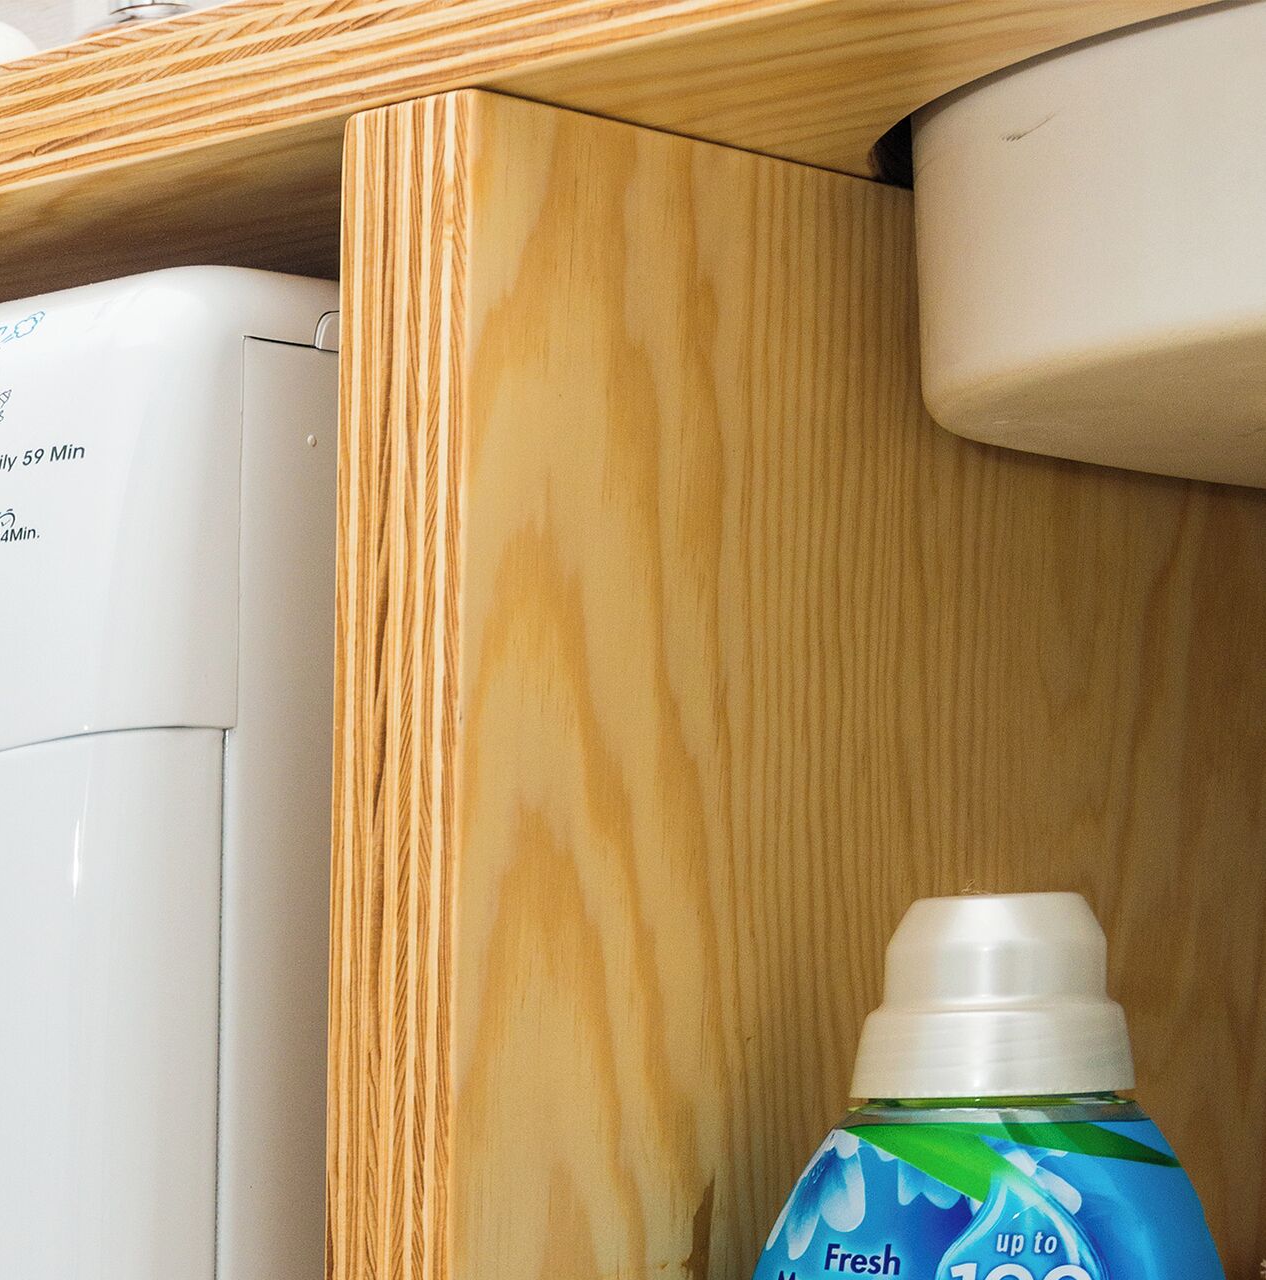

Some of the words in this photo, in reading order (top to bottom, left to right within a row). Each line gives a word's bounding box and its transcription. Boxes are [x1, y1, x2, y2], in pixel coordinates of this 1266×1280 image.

[22, 448, 45, 466] 59
[49, 444, 85, 462] Min
[995, 1232, 1024, 1256] up
[1033, 1229, 1058, 1254] to
[824, 1242, 901, 1277] Fresh
